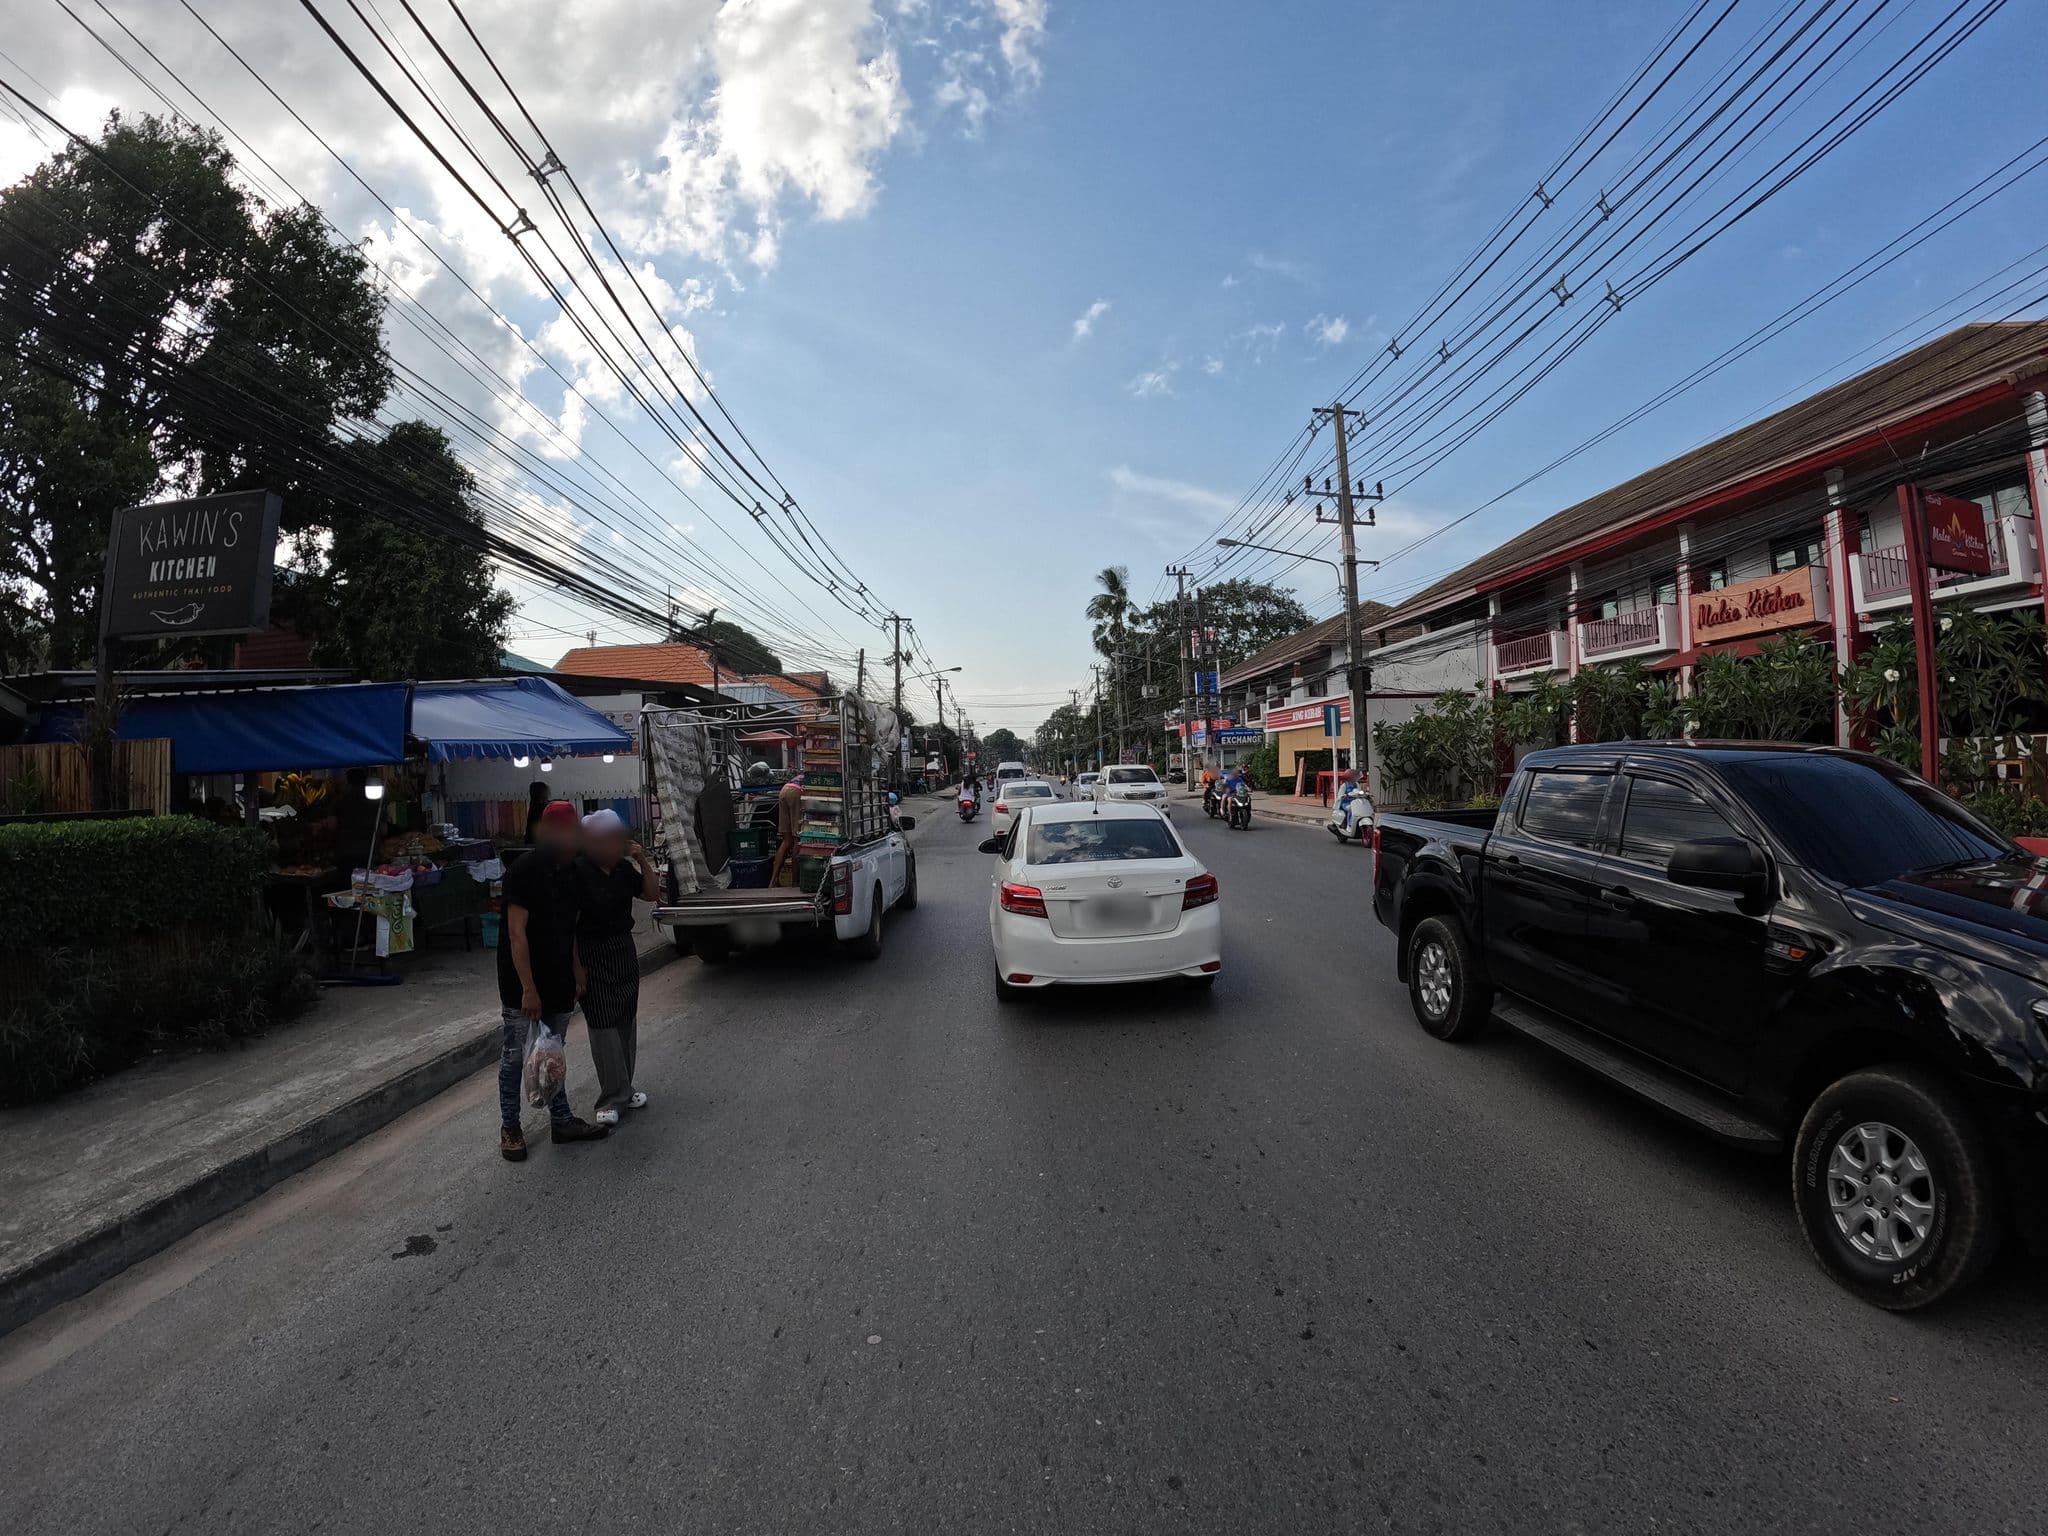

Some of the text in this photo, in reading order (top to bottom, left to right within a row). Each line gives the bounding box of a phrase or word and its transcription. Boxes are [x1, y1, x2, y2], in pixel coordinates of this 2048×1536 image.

[139, 508, 243, 557] KAWIN'S
[149, 556, 217, 583] KITCHEN
[132, 584, 233, 600] AUTHENTIC THAI FOOD
[1697, 585, 1806, 630] Malee Kitchen
[1221, 735, 1263, 745] EXCHANGE
